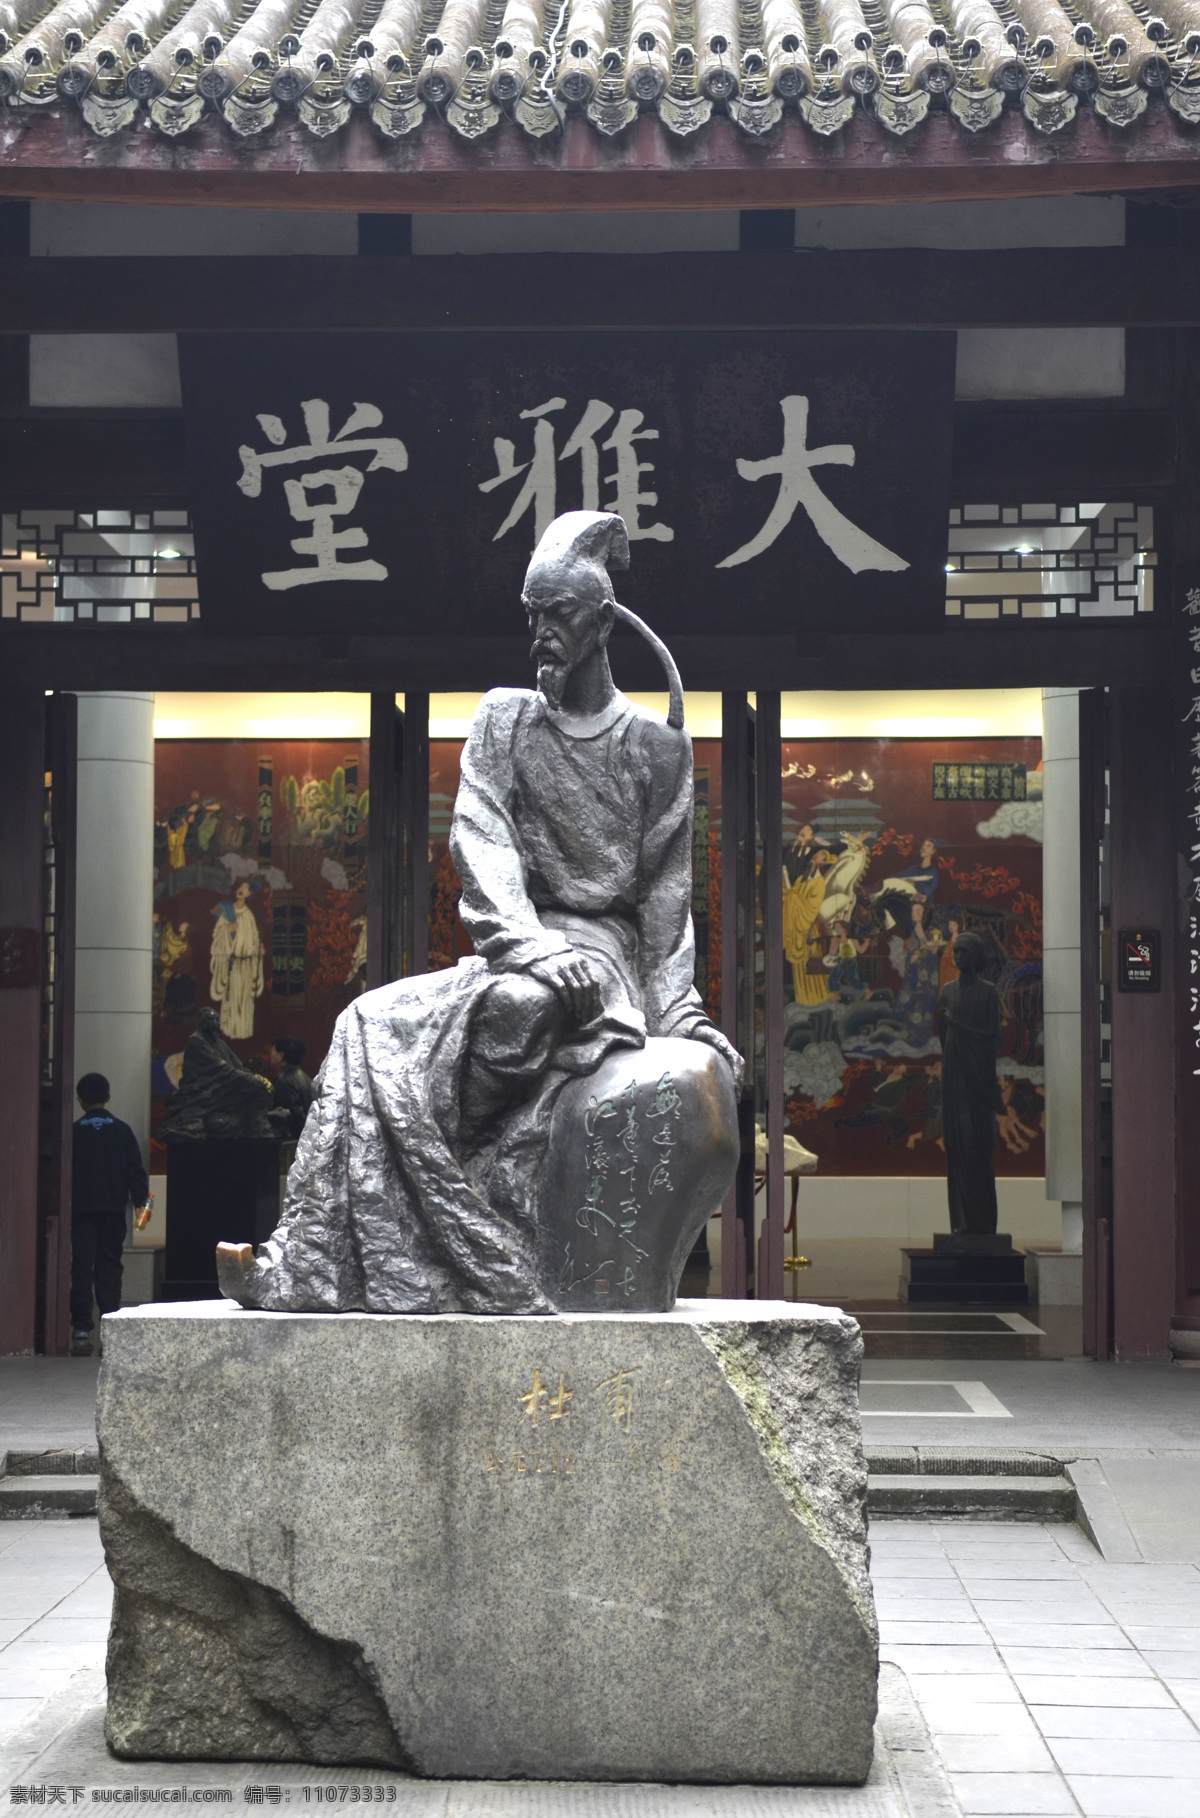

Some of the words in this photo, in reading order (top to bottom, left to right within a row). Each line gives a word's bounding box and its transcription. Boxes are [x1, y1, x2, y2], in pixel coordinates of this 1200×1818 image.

[237, 395, 910, 591] 大雅堂
[518, 1366, 643, 1433] 杜甫
